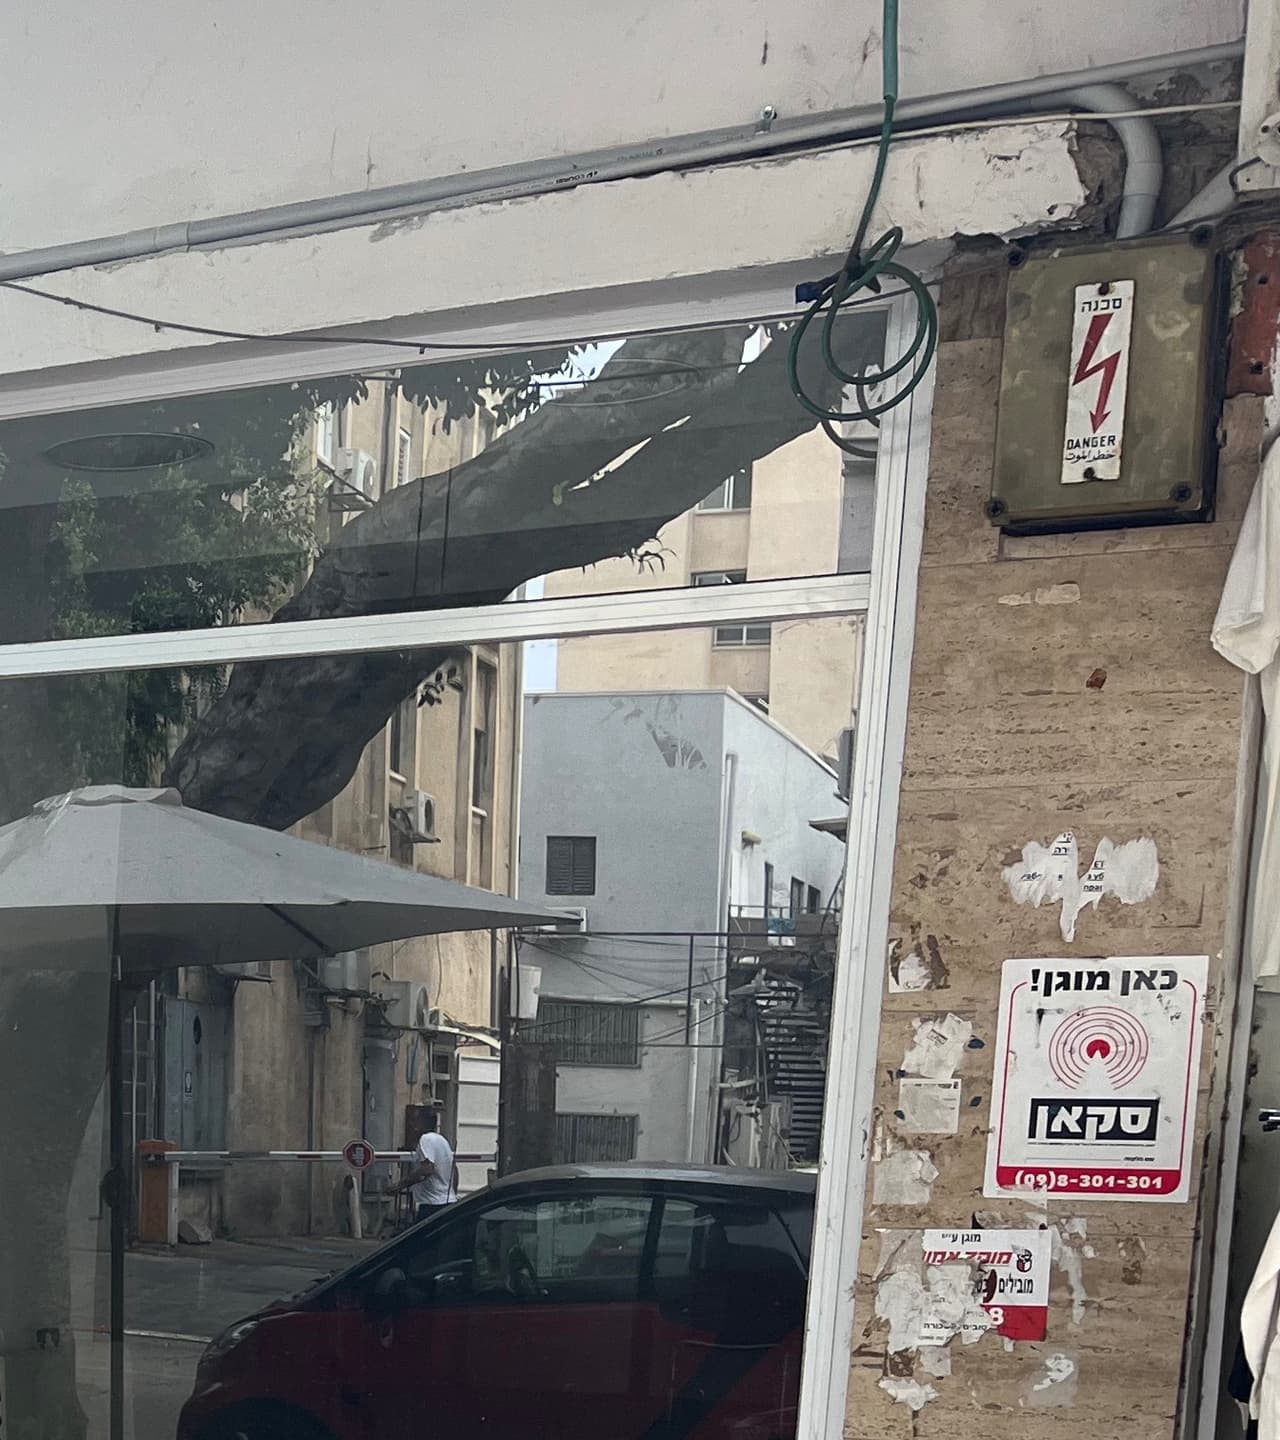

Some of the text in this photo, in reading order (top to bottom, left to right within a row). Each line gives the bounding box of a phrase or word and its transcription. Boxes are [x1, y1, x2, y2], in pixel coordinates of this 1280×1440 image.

[1081, 298, 1122, 312] סכנה
[1066, 435, 1116, 450] DANGER
[1030, 968, 1179, 997] כאן מוגן!
[1035, 1105, 1152, 1140] סקאן
[998, 1273, 1034, 1294] מובילים
